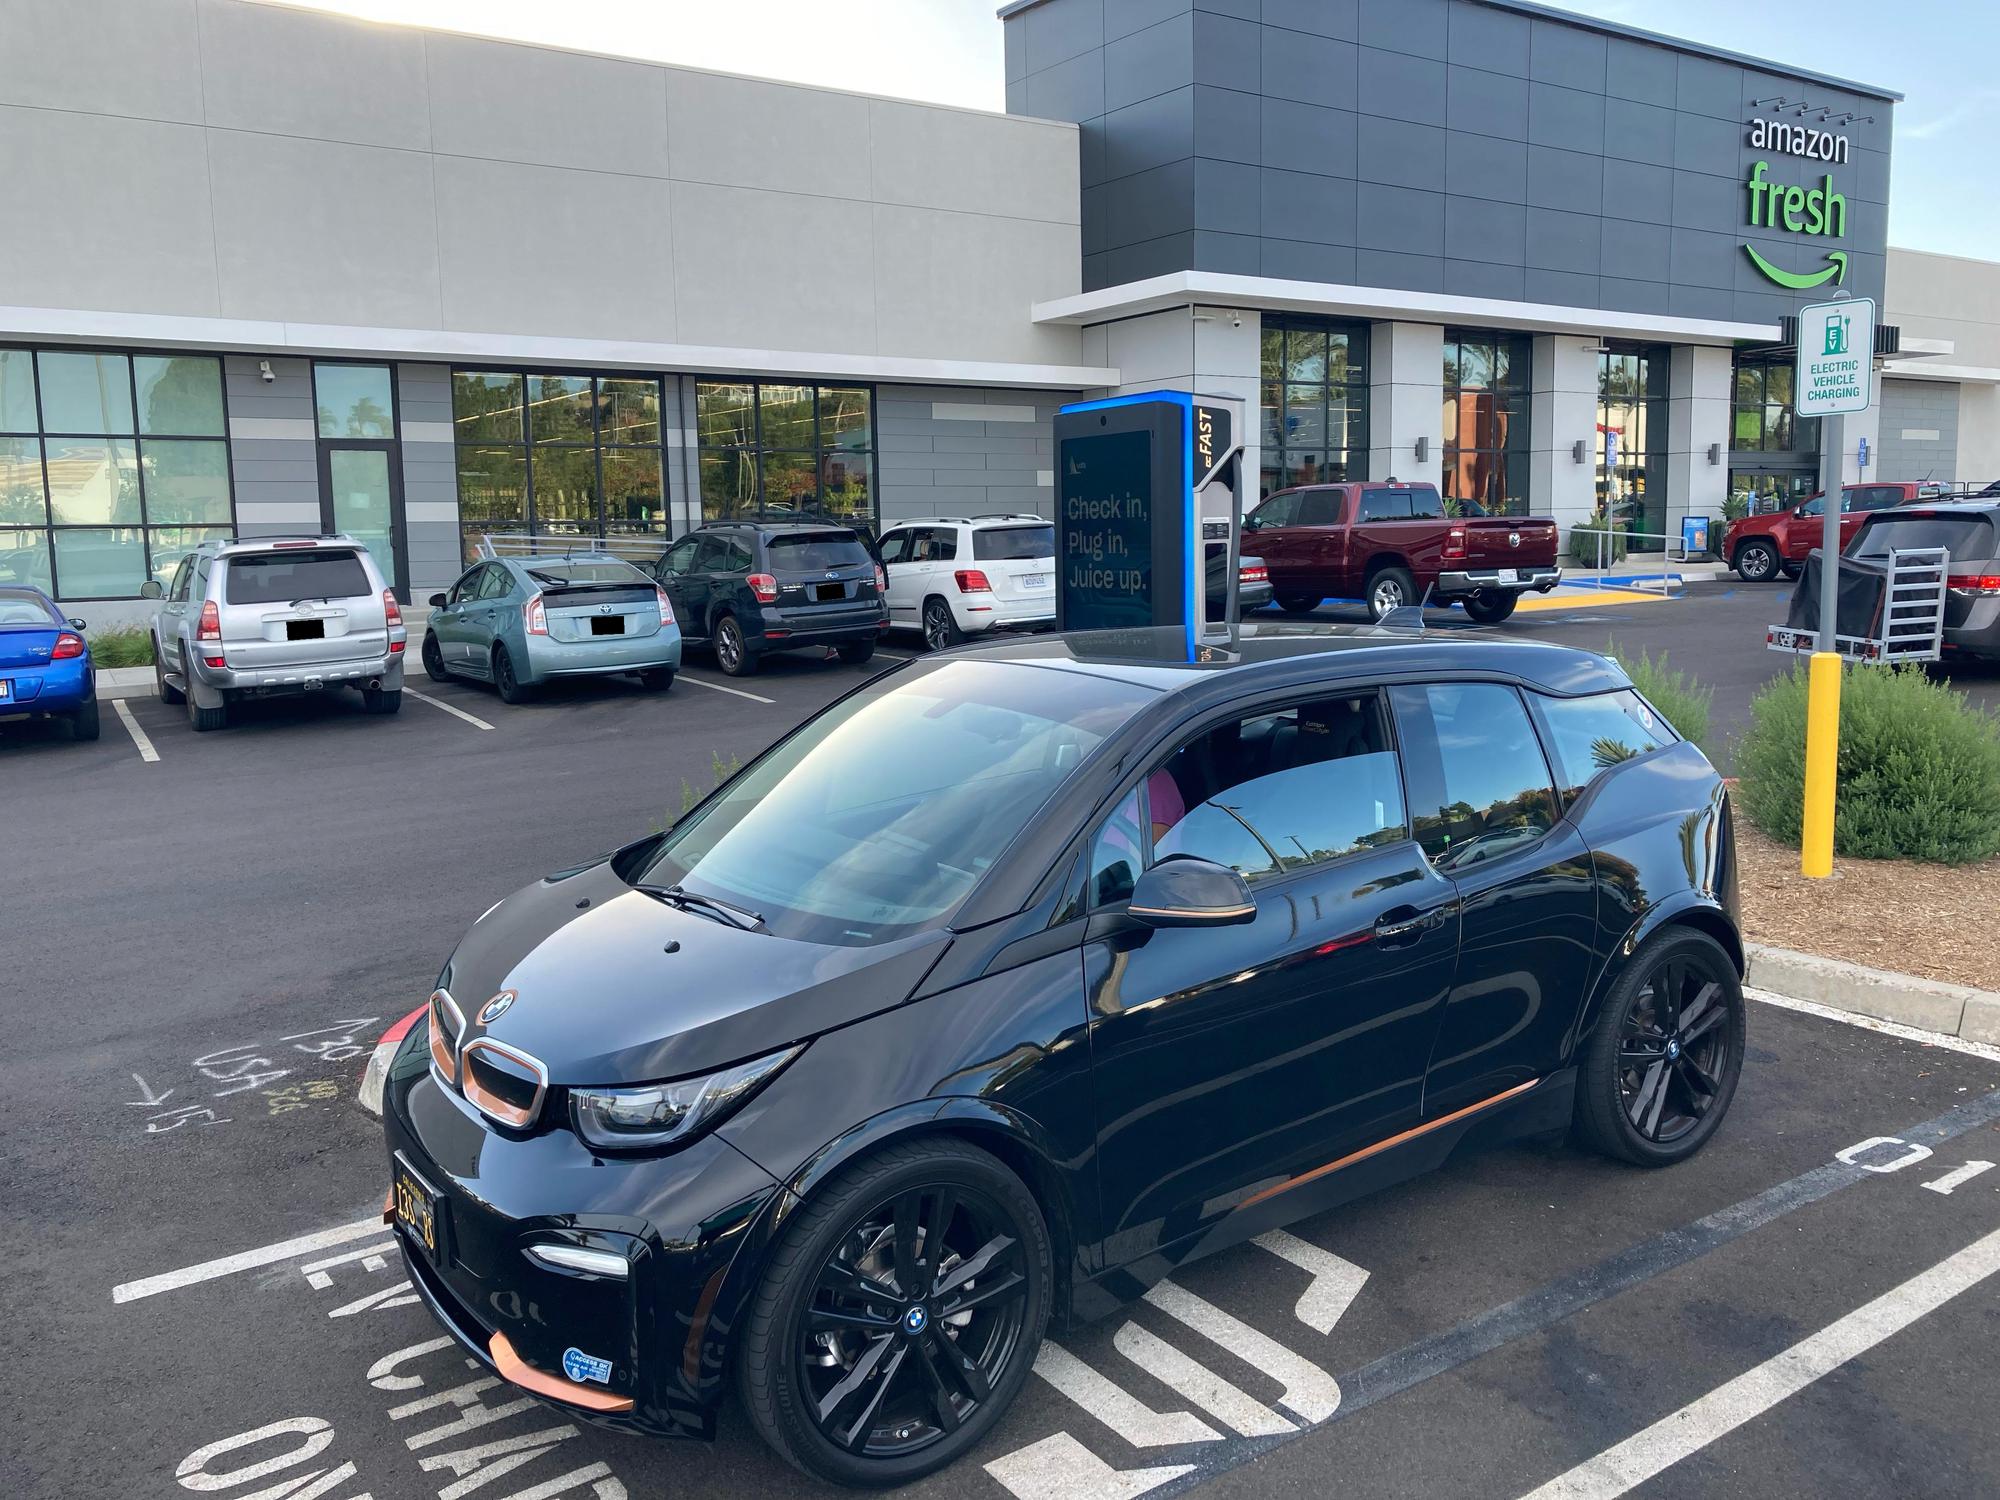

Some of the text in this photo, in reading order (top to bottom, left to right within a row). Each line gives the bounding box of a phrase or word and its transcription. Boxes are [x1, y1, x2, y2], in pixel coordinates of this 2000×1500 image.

[1752, 117, 1849, 164] amazon
[1750, 160, 1846, 237] fresh
[1828, 329, 1837, 350] EV
[1810, 360, 1858, 374] ELECTRIC
[1813, 374, 1855, 387] VEHICLE
[1807, 386, 1860, 401] CHARGING
[1199, 408, 1212, 455] FAST
[1068, 492, 1148, 522] Check in,
[1069, 531, 1129, 561] Plug in,
[1070, 566, 1114, 589] Juice
[1119, 575, 1147, 595] up.
